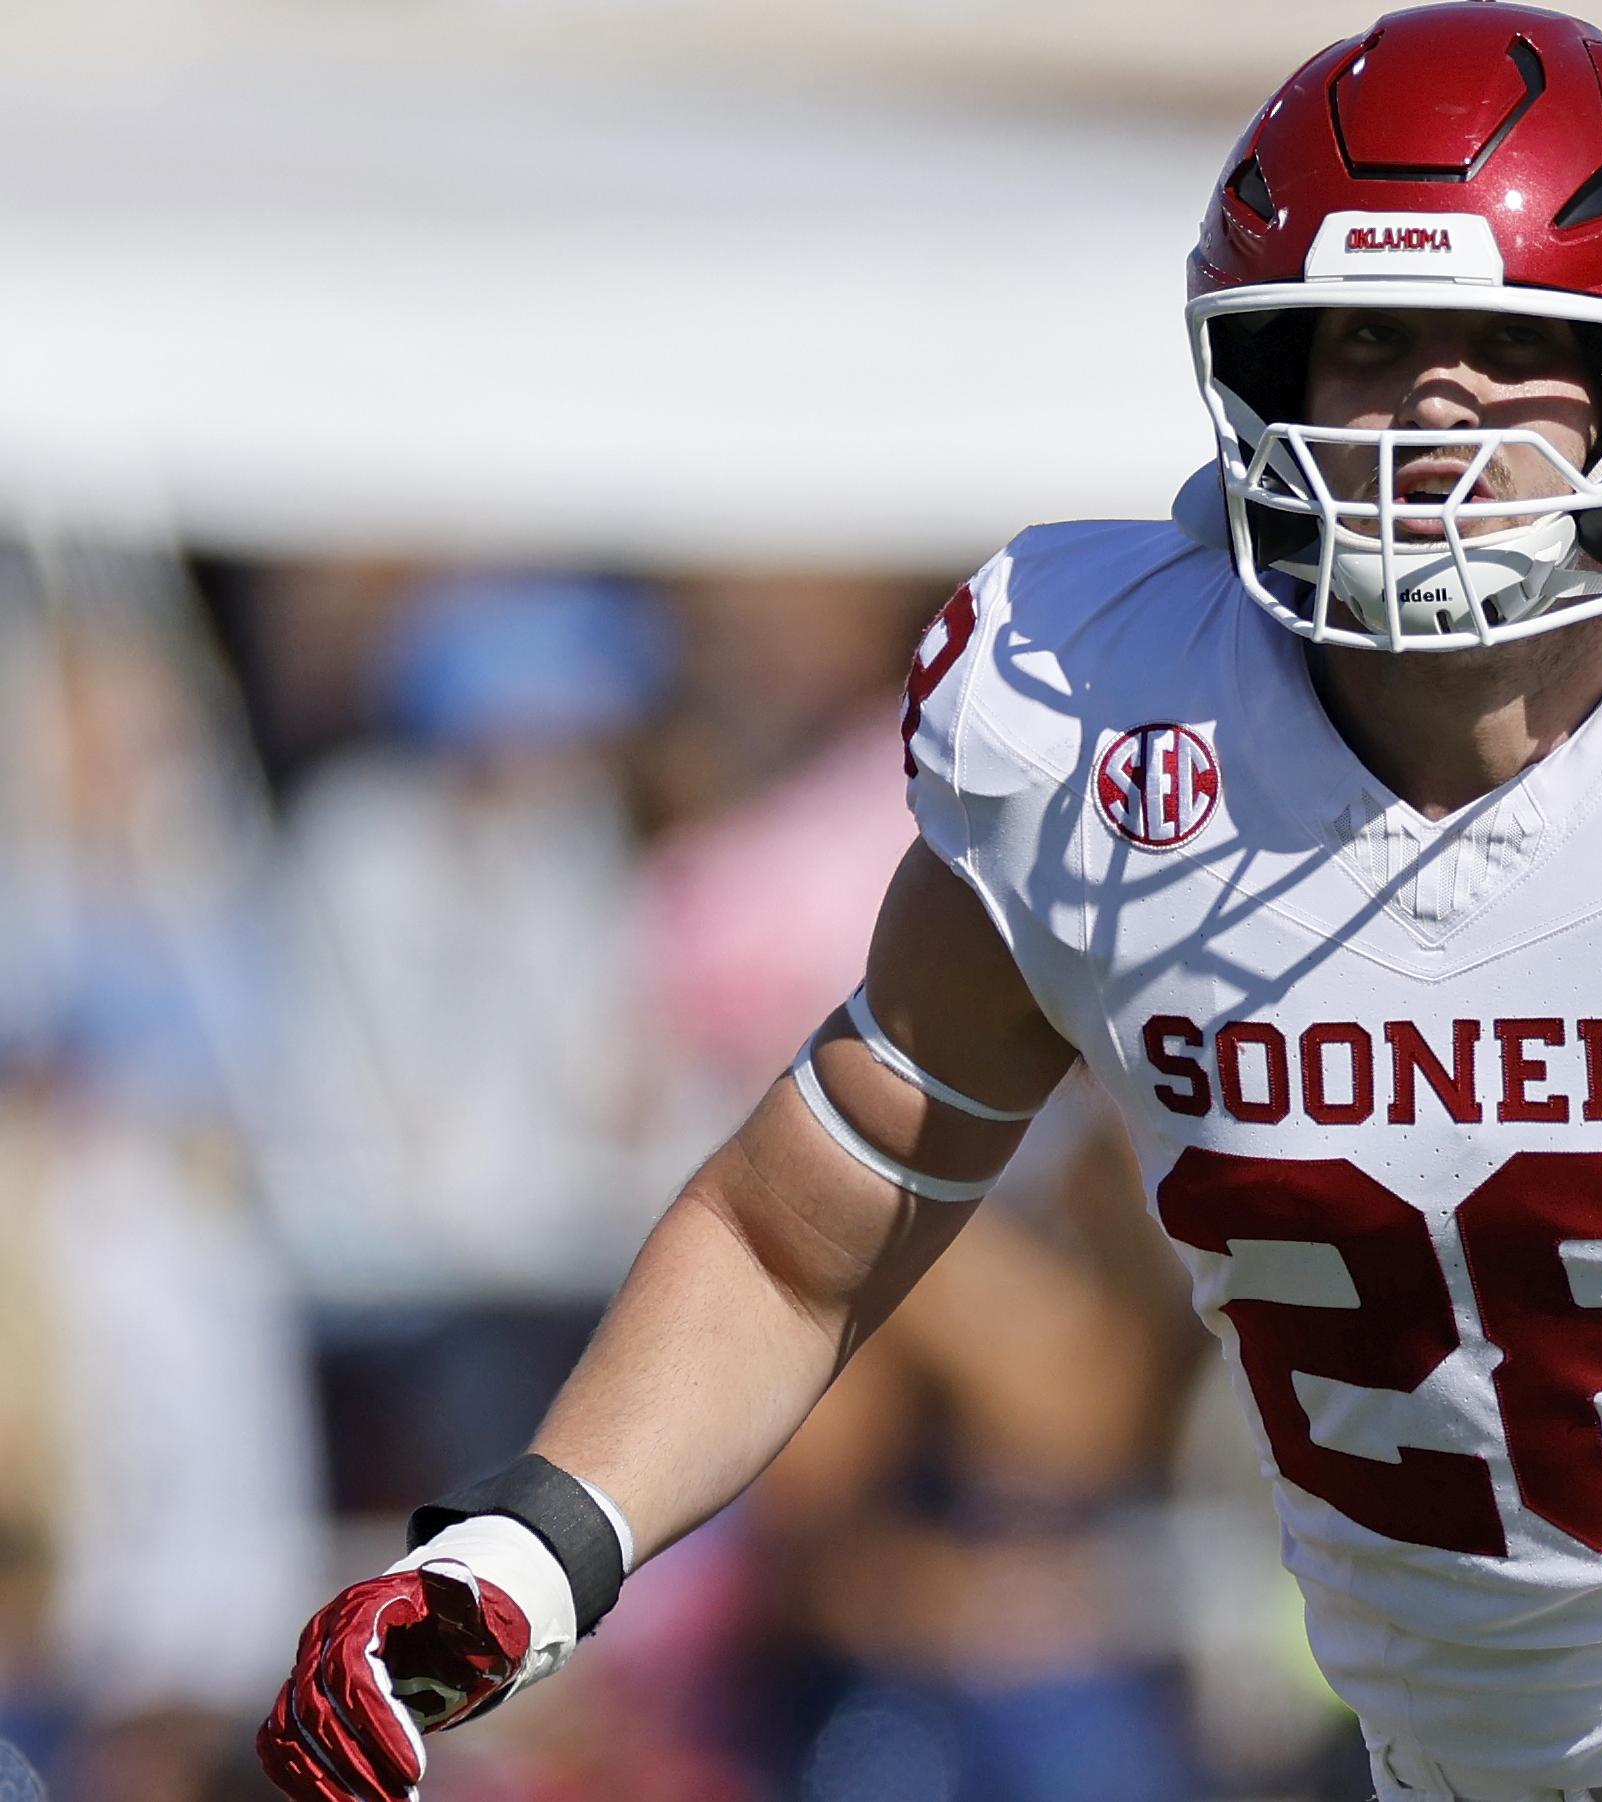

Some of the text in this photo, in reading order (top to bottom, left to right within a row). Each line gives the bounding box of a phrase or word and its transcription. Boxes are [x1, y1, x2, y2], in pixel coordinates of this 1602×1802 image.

[1346, 227, 1452, 252] OKLAHOMA
[1381, 588, 1448, 602] ddell
[1106, 729, 1211, 841] SEC
